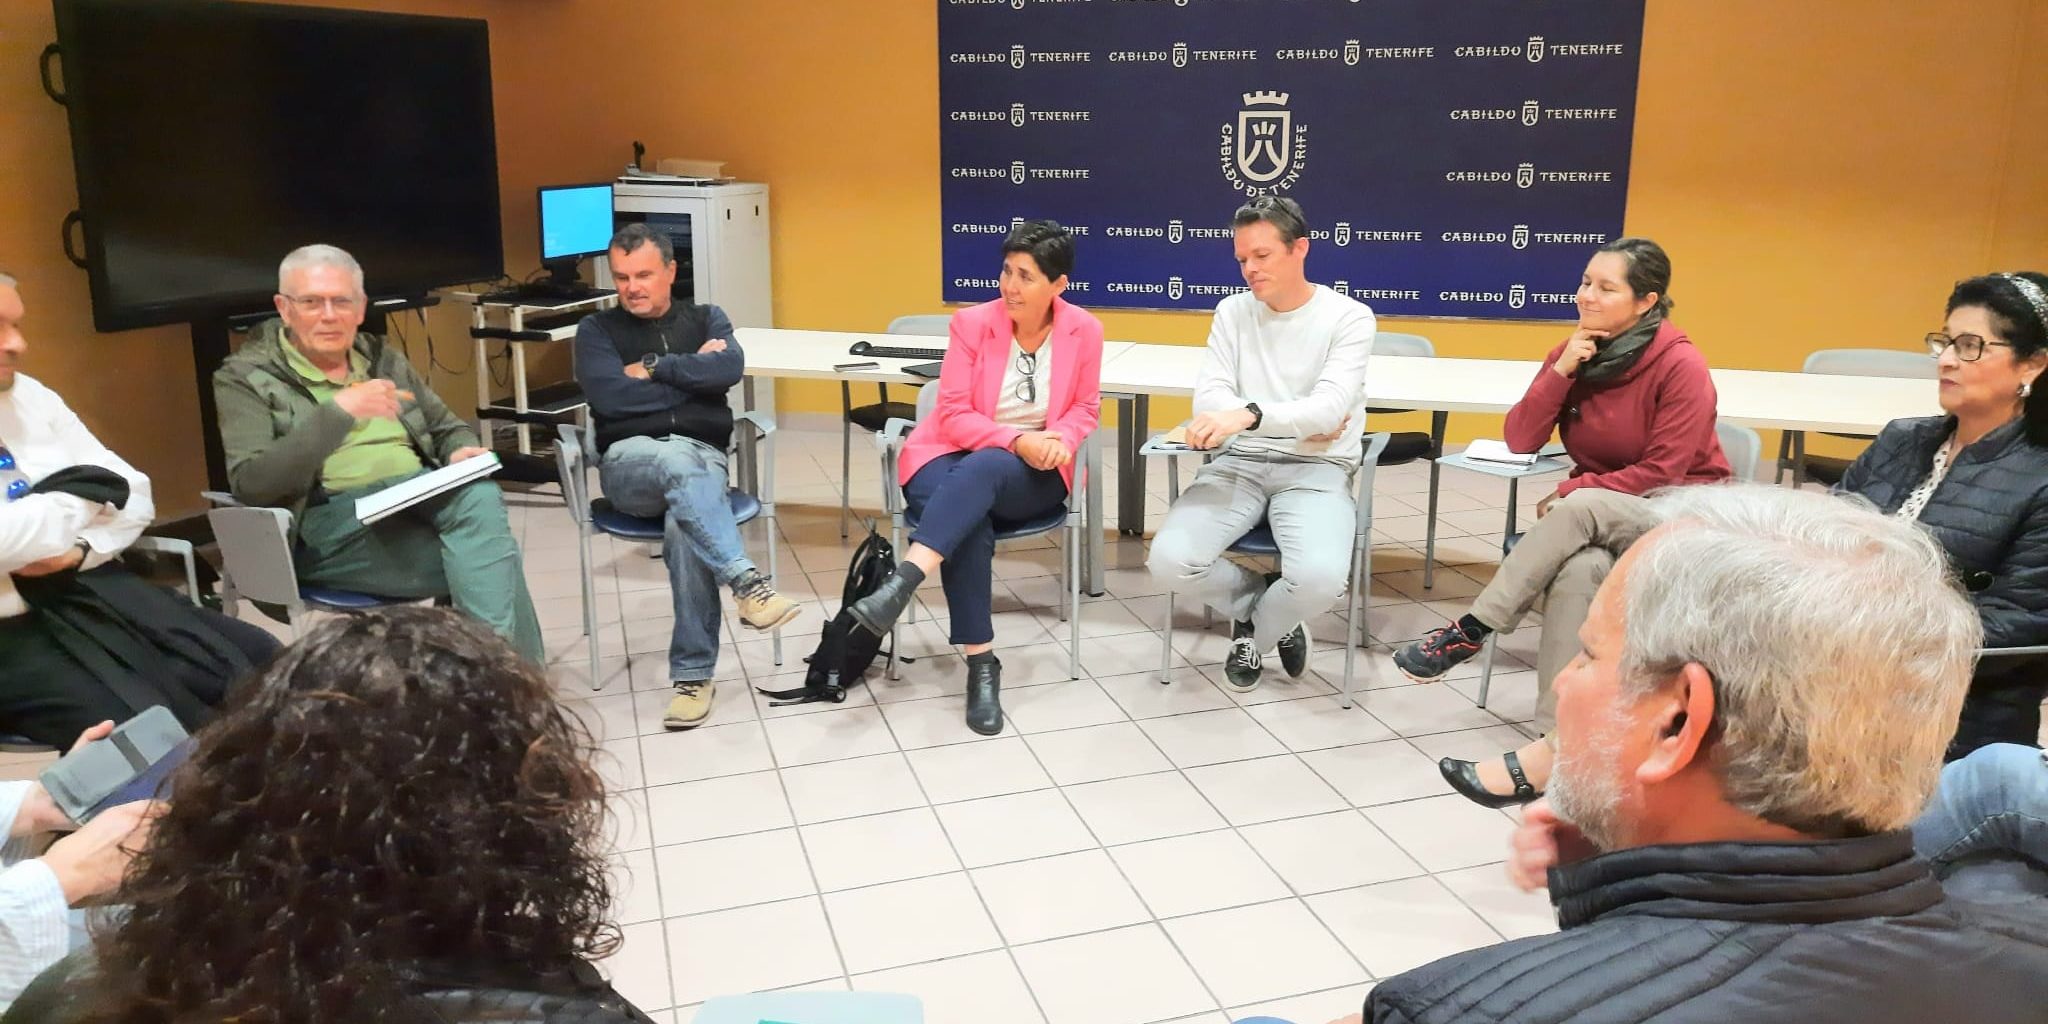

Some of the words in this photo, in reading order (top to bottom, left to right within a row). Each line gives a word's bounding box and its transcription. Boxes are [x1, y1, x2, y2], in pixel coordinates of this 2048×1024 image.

[1109, 52, 1167, 62] CABILDO
[1193, 50, 1257, 61] TENERIFE
[1276, 49, 1338, 60] CABILDO
[1366, 47, 1434, 58] TENERIFE
[1454, 46, 1521, 57] CABILDO
[1551, 44, 1624, 56] TENERIFE
[950, 53, 1006, 63] CABILDO
[1030, 52, 1091, 62] TENERIFE
[950, 111, 1006, 121] CABILDO
[1030, 111, 1090, 121] TENERIFE
[1450, 109, 1516, 120] CABILDO
[1545, 108, 1617, 119] TENERIFE
[1221, 122, 1245, 190] CABILDO
[1246, 185, 1267, 197] DE
[1269, 124, 1308, 195] TENERIFE
[951, 168, 1007, 178] CABILDO
[1030, 169, 1090, 179] TENERIFE
[1446, 171, 1511, 182] CABILDO
[1539, 172, 1612, 182] TENERIFE
[952, 223, 1007, 234] CABILDO
[1106, 226, 1163, 237] CABILDO
[1187, 228, 1234, 239] TENERI
[1355, 230, 1422, 241] TENERIFE
[1441, 231, 1507, 243] CABILDO
[1534, 233, 1606, 244] TENERIFE
[954, 278, 1000, 288] CABILD
[1106, 282, 1163, 293] CABILDO
[1353, 289, 1420, 300] TENERIFE
[1439, 291, 1503, 303] CABILDO
[1531, 293, 1578, 304] TENER
